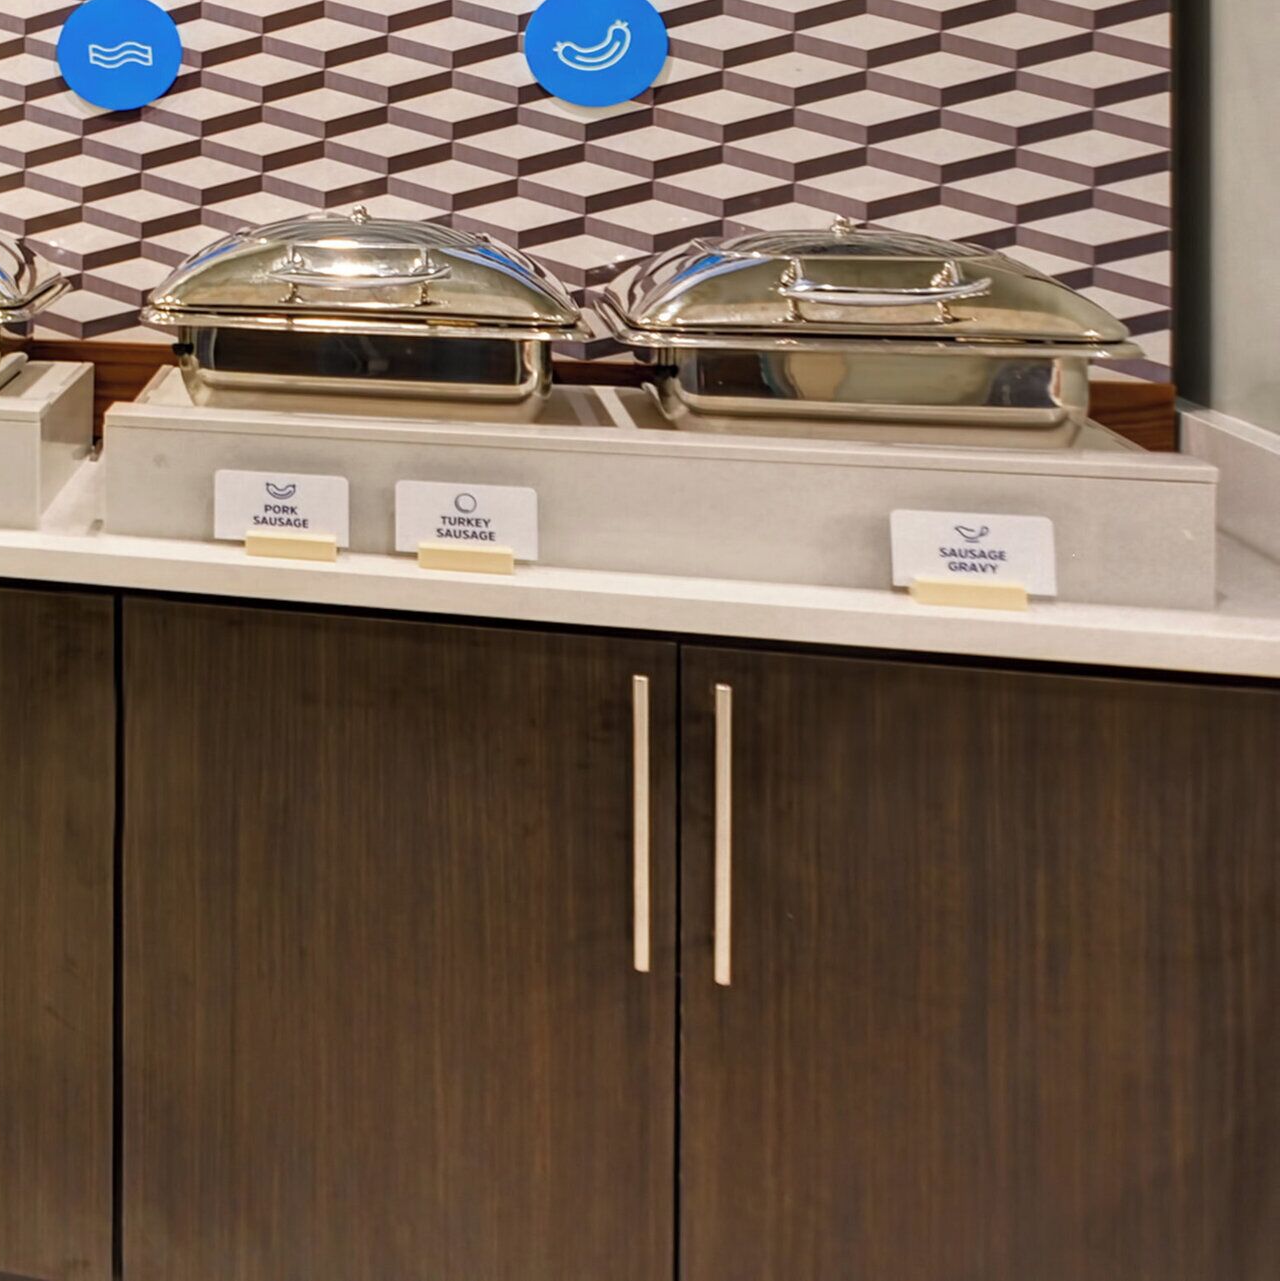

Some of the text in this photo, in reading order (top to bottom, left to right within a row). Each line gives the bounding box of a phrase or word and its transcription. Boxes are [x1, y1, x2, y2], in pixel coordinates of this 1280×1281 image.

[264, 504, 298, 516] PORK
[253, 515, 309, 529] SAUSAGE
[440, 515, 491, 529] TURKEY
[436, 527, 496, 542] SAUSAGE
[939, 547, 1007, 562] SAUSAGE
[948, 561, 1000, 575] GRAVY
